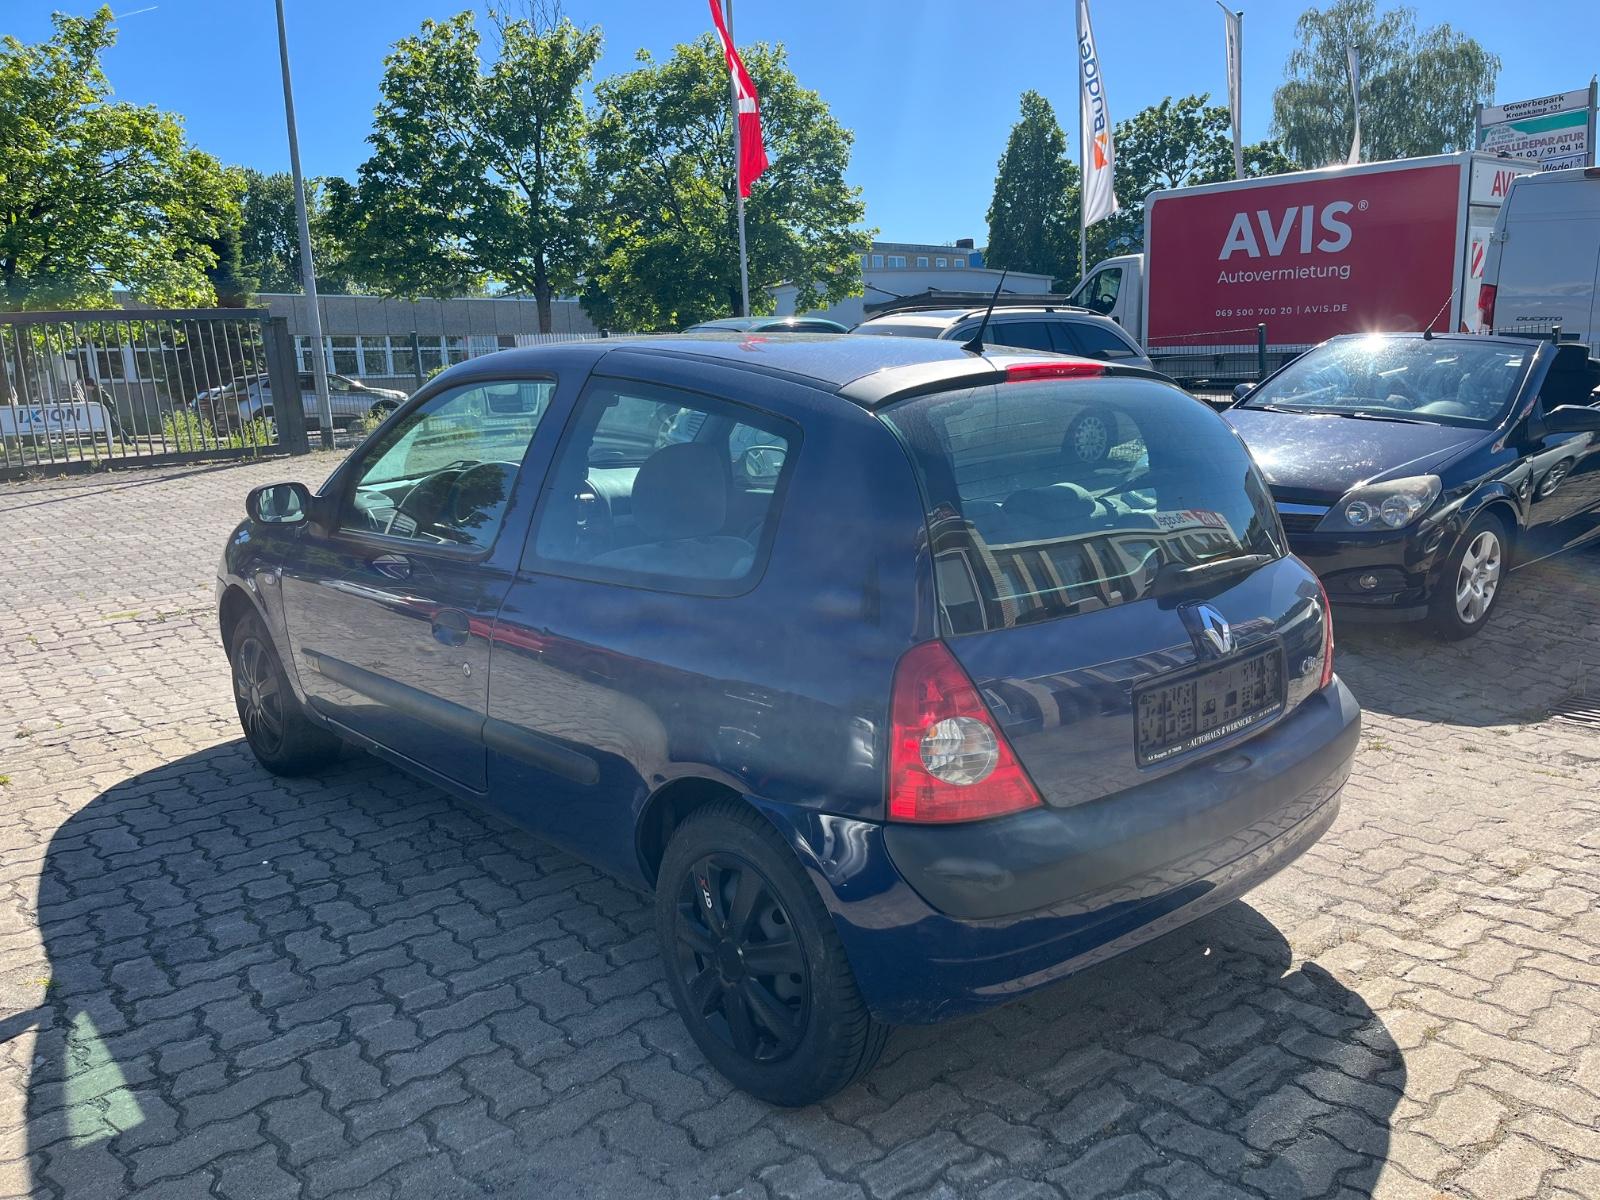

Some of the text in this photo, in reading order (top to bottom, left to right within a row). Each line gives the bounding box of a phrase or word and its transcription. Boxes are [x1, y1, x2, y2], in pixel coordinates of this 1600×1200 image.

[1079, 31, 1105, 133] Budget
[1503, 95, 1564, 112] Gewerbepark
[1547, 147, 1556, 155] 91
[1560, 145, 1571, 153] 94
[1491, 170, 1521, 197] AV
[1218, 201, 1354, 260] AVIS
[1217, 265, 1351, 284] Autovermietung
[1216, 309, 1232, 317] 069
[1236, 308, 1254, 316] 500
[1258, 307, 1276, 315] 700
[1280, 306, 1292, 315] 20
[1304, 303, 1348, 314] AVIS.DE
[19, 408, 80, 423] IXION
[1190, 716, 1252, 747] AUTOHAUS WERNICKE
